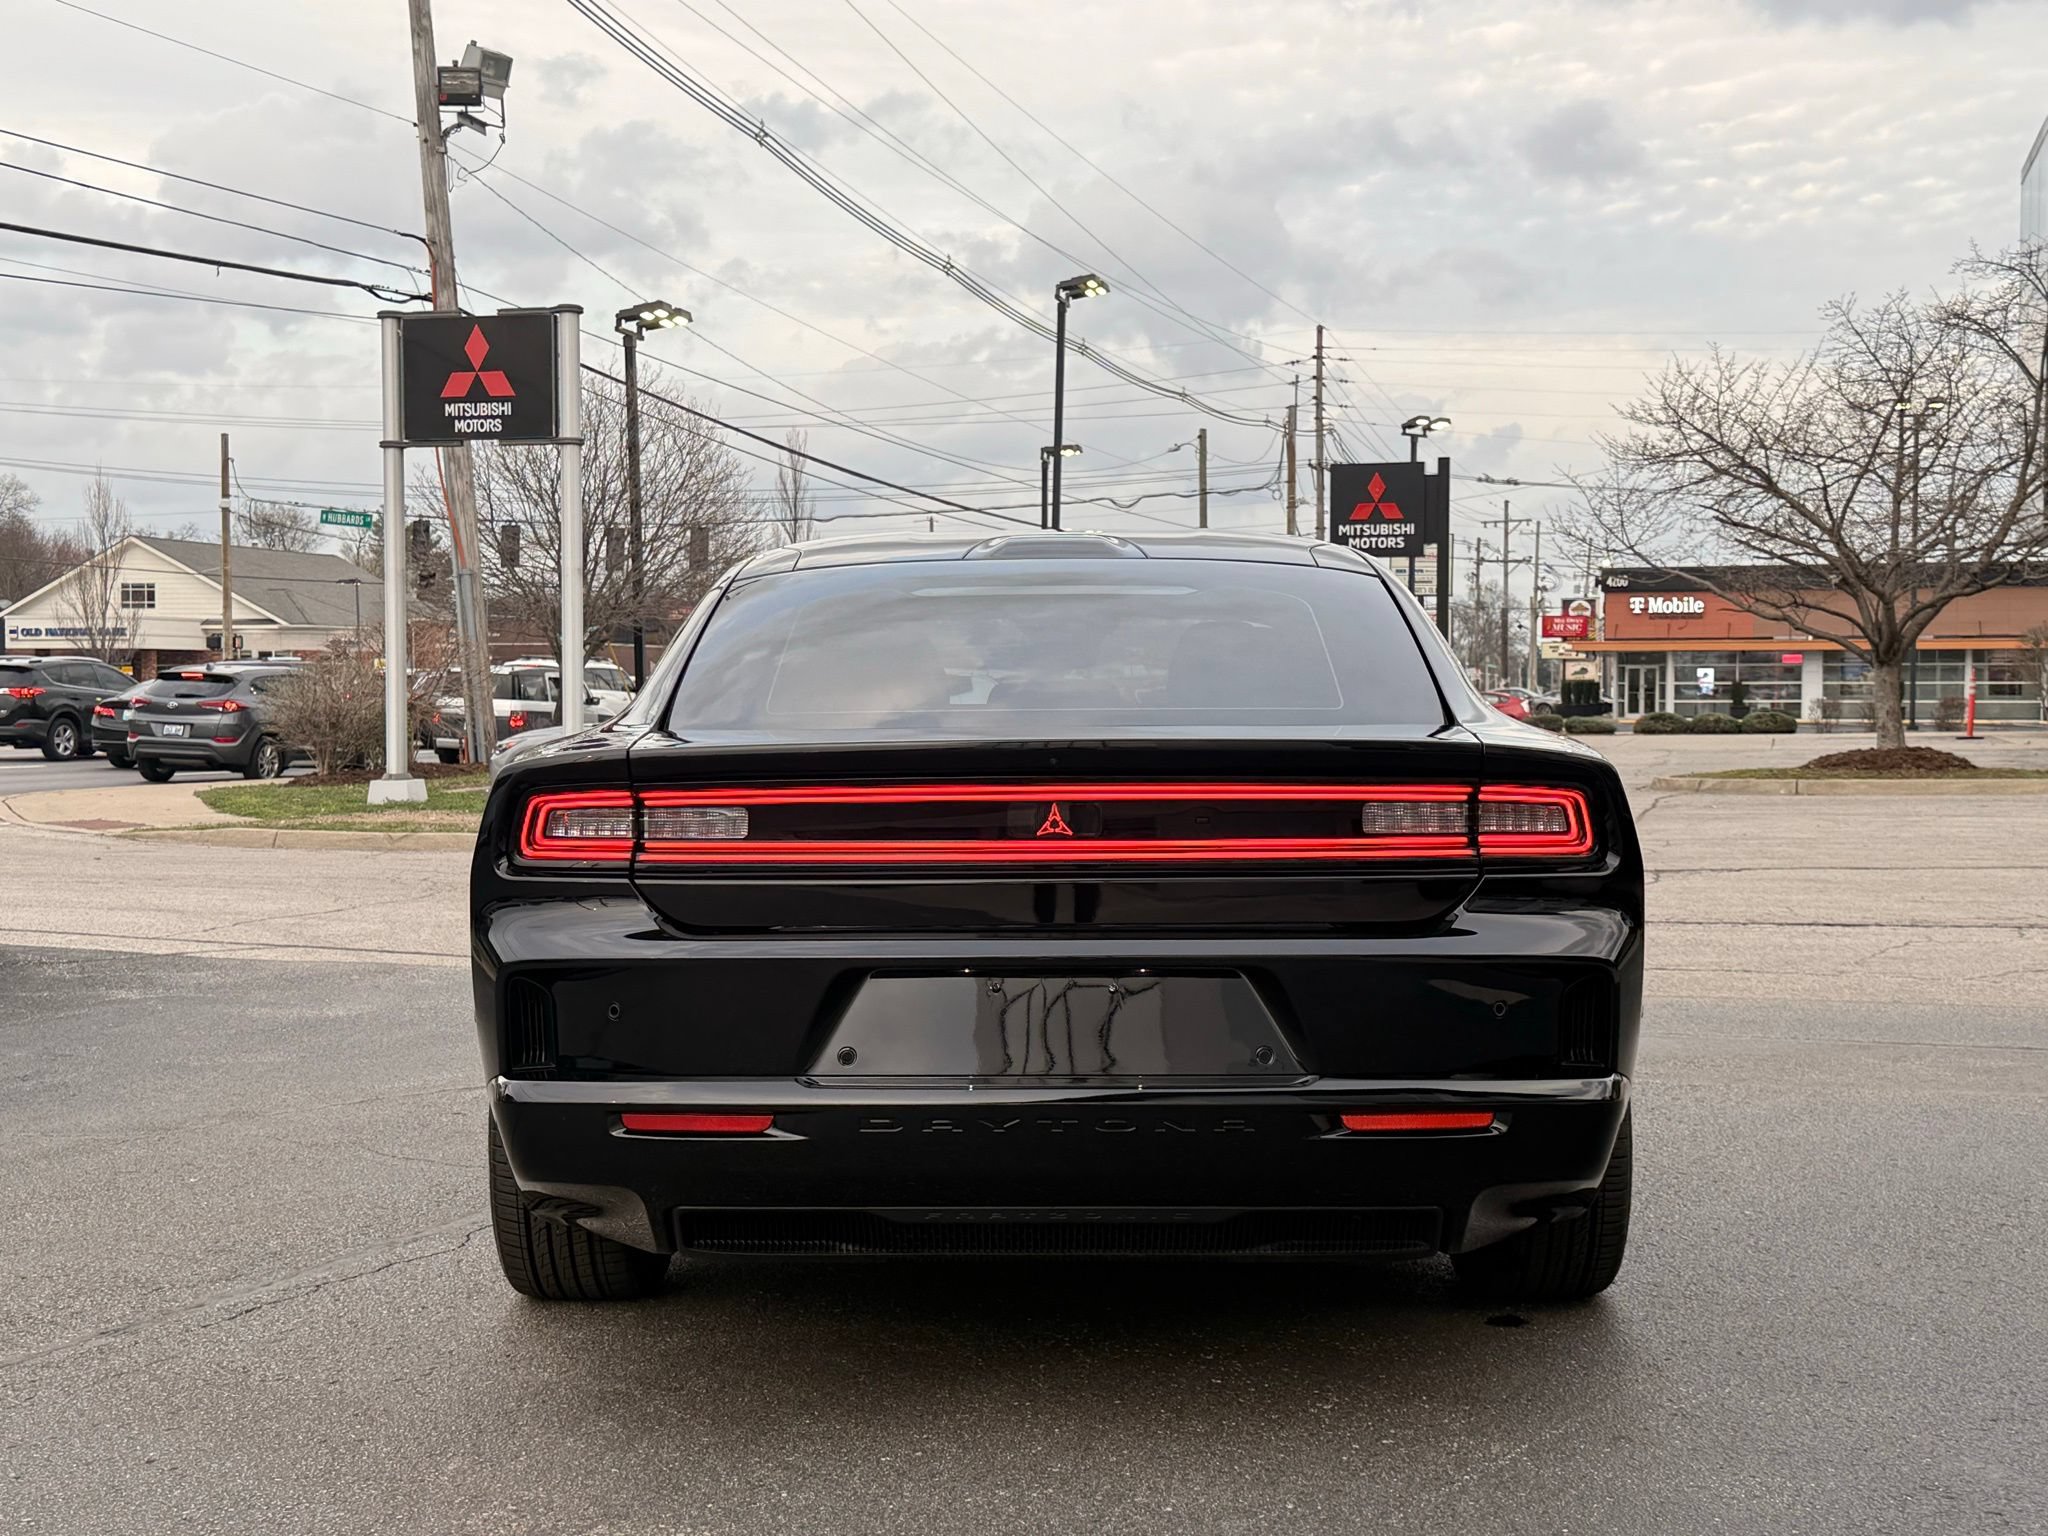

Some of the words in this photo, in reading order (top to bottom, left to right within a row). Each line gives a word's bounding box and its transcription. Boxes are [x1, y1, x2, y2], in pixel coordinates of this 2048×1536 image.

[444, 402, 512, 417] MITSUBISHI
[454, 419, 503, 433] MOTORS
[327, 512, 364, 526] HUBBARDS
[1338, 523, 1415, 536] MITSUBISHI
[1348, 537, 1405, 549] MOTORS
[20, 627, 42, 636] OLD
[859, 1119, 1256, 1132] DAYTONA
